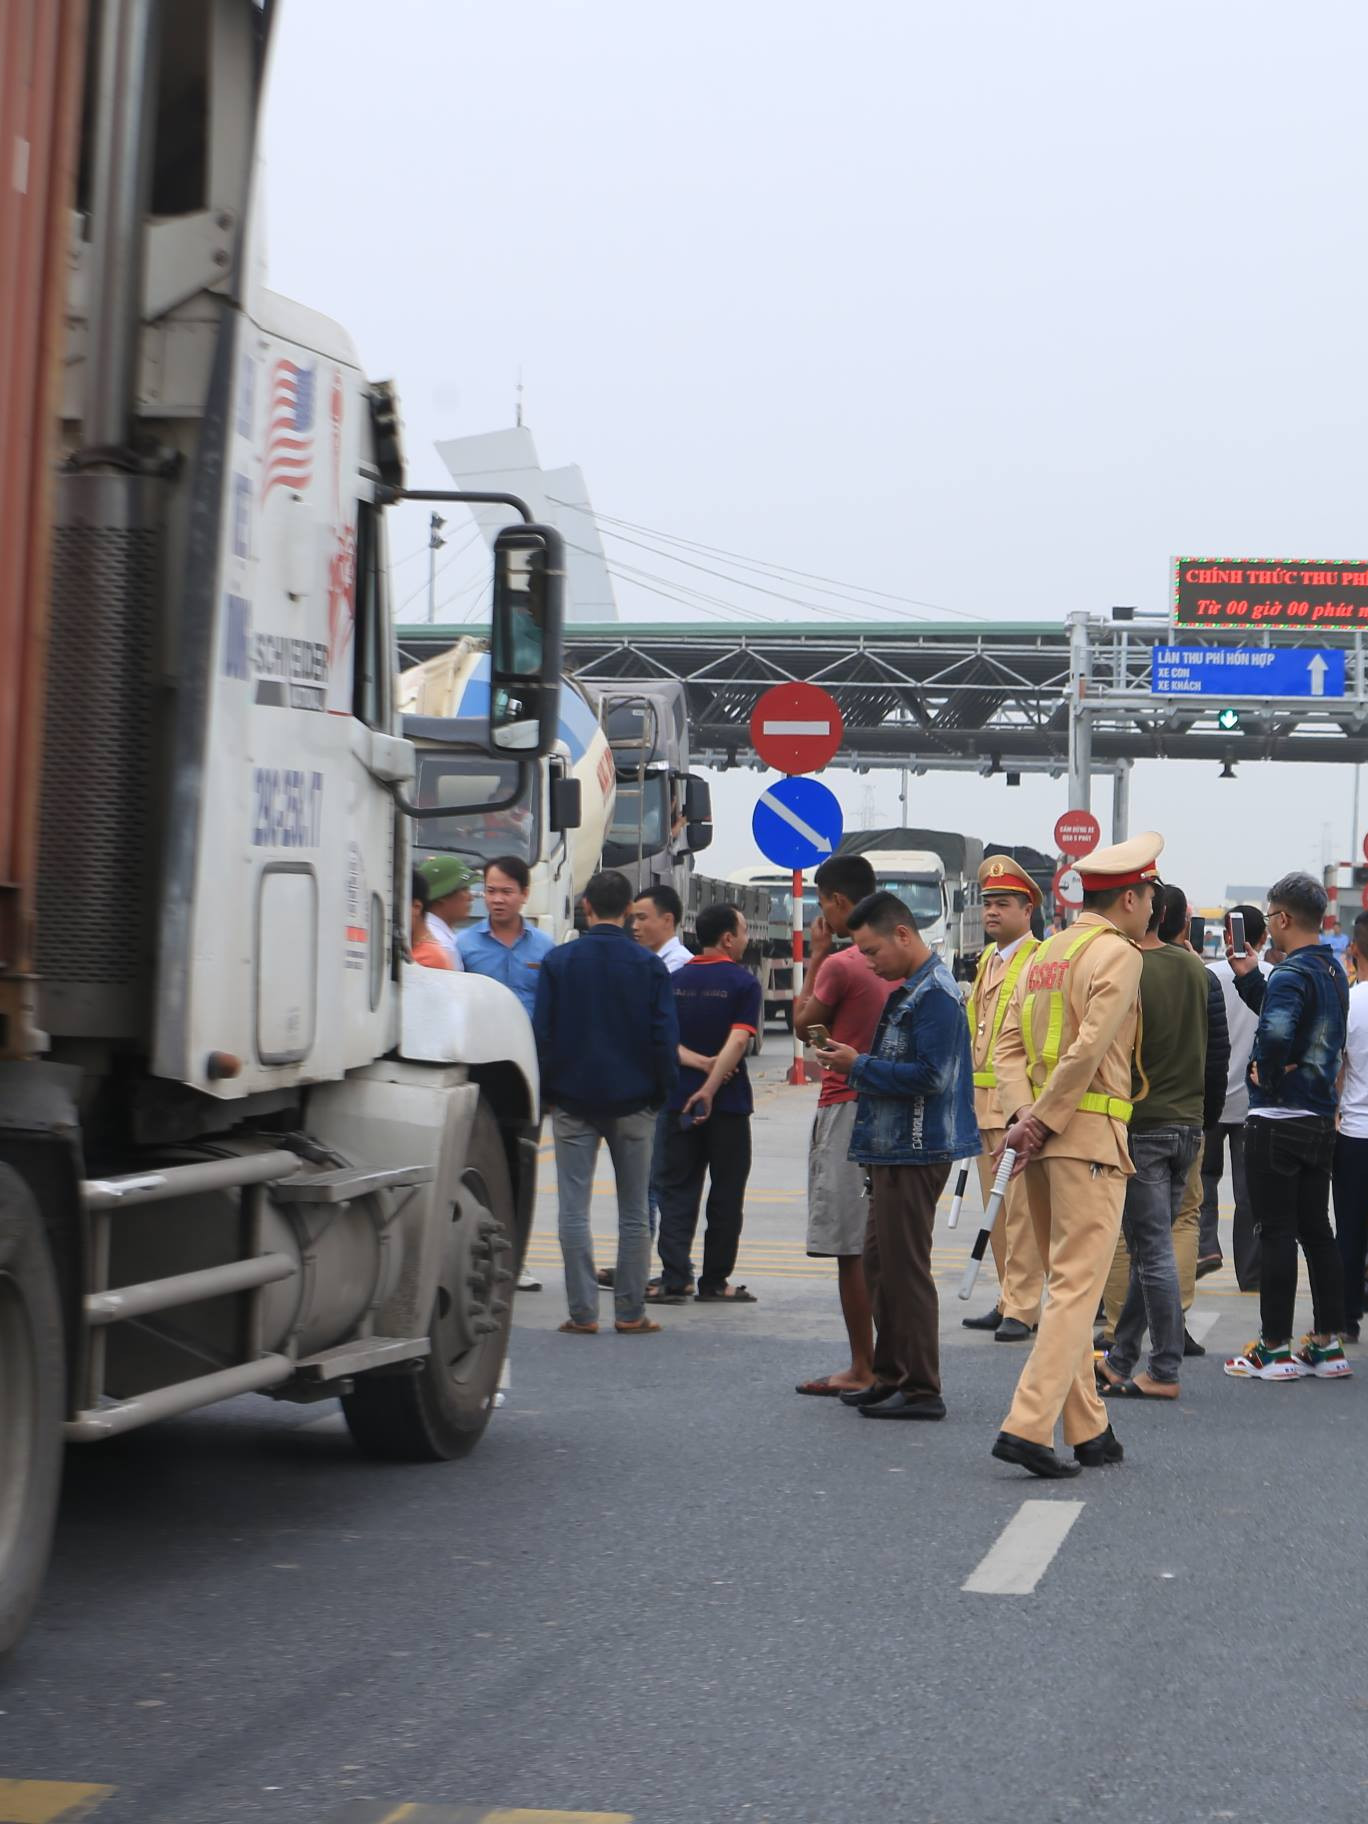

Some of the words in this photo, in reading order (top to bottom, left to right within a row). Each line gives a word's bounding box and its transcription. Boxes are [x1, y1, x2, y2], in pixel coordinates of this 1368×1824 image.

[1186, 567, 1243, 584] CHÍNH
[1247, 567, 1298, 585] THỨC
[1300, 571, 1338, 585] THU
[1197, 600, 1221, 616] Từ
[1226, 601, 1248, 616] 00
[1251, 601, 1282, 619] giờ
[1287, 601, 1309, 617] 00
[1312, 603, 1353, 620] phút
[1158, 649, 1180, 664] LÀN
[1183, 652, 1201, 664] THU
[1205, 650, 1224, 665] PHÍ
[1251, 653, 1275, 668] HỢP
[1158, 668, 1170, 678] XE
[1171, 668, 1190, 678] CON
[1158, 681, 1170, 691] XE
[1171, 679, 1201, 691] KHÁCH
